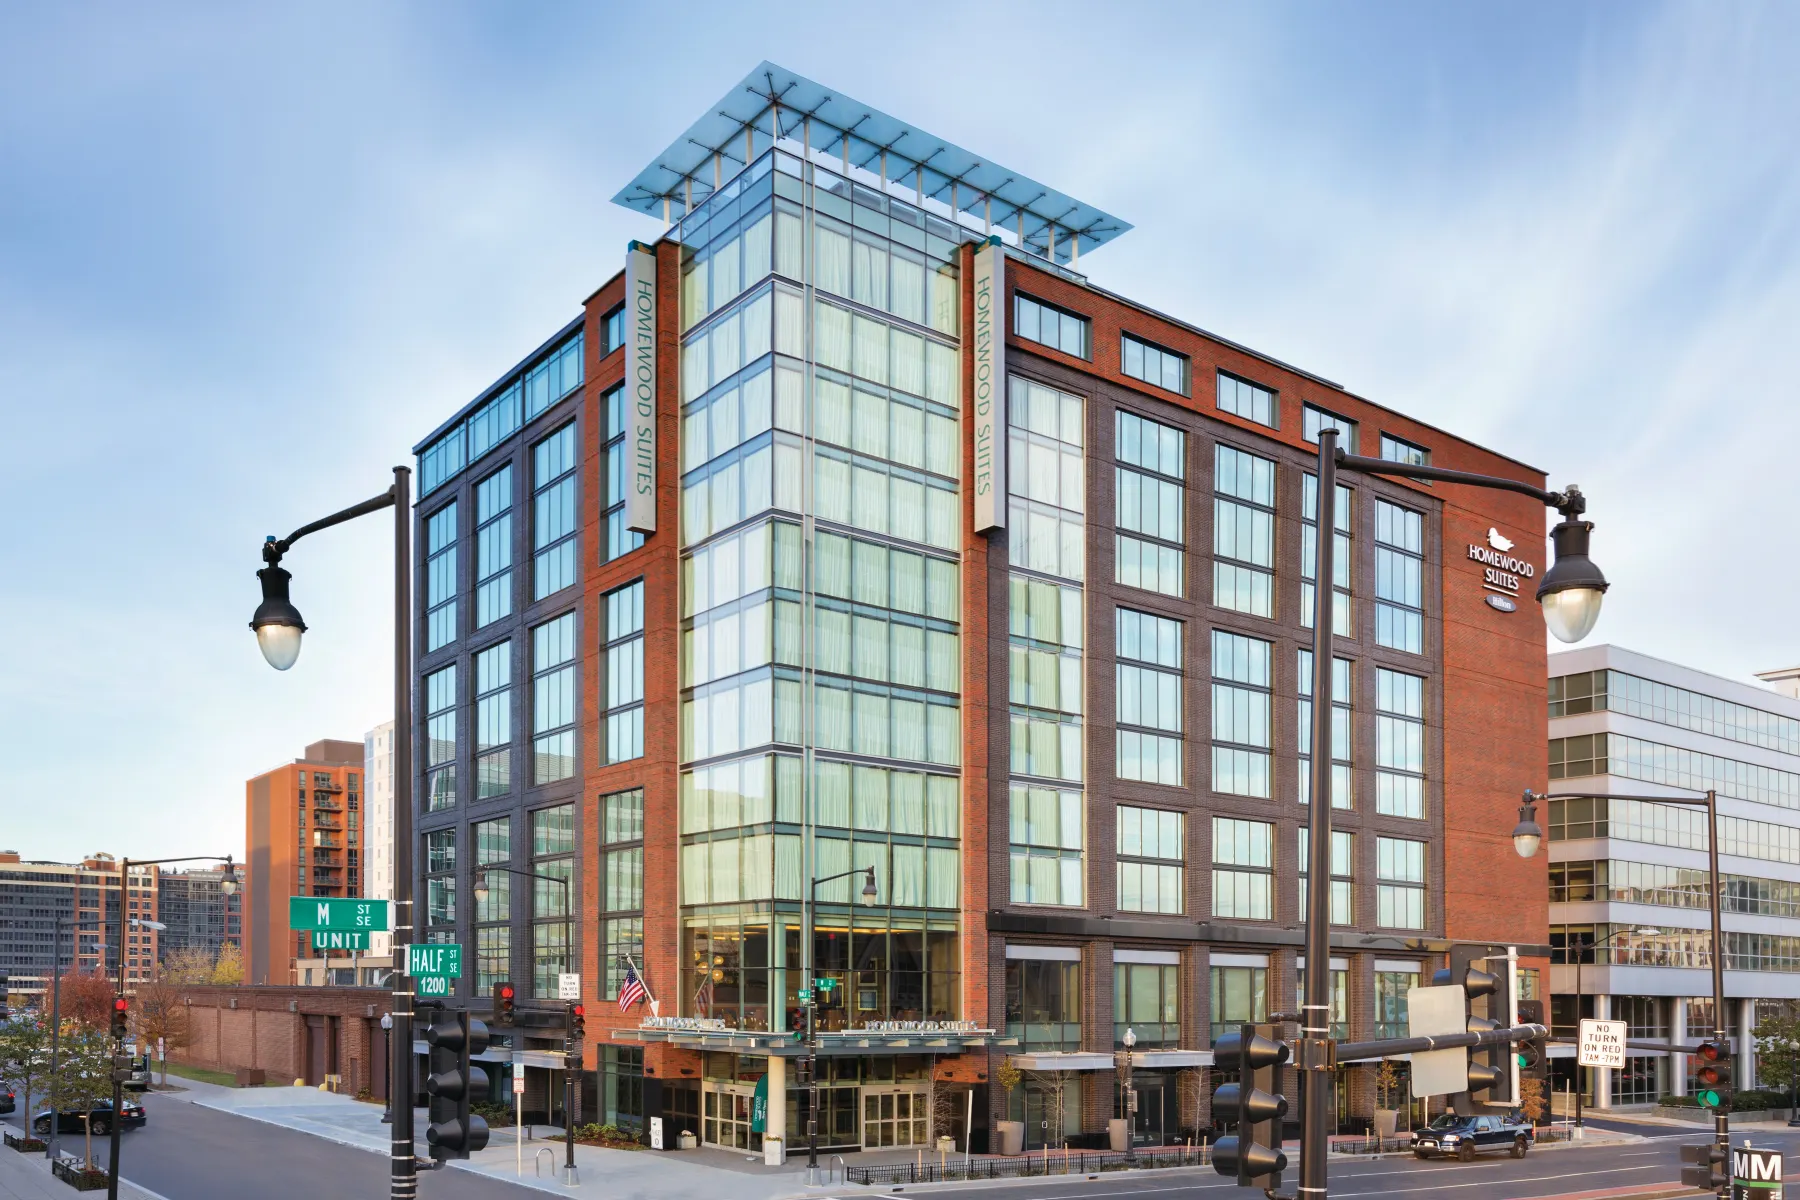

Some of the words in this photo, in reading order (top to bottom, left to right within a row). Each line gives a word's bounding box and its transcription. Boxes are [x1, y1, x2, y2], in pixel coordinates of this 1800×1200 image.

[637, 279, 653, 418] HOMEWOOD
[977, 275, 991, 416] HOMEWOOD
[636, 425, 653, 496] SUITES
[977, 423, 991, 496] SUITES
[1469, 544, 1534, 577] HOMEWOOD
[1485, 568, 1519, 590] SUITES
[317, 902, 330, 926] M
[357, 904, 371, 915] ST
[356, 916, 372, 926] SE
[316, 931, 362, 949] UNIT
[412, 949, 445, 973] HALF
[449, 949, 458, 959] ST
[449, 963, 458, 973] SE
[420, 976, 445, 994] 1200
[1588, 1033, 1618, 1043] TURN
[1596, 1024, 1610, 1033] NO
[1584, 1043, 1597, 1052] ON
[1602, 1044, 1621, 1054] RED
[1733, 1151, 1749, 1180] M
[1751, 1153, 1782, 1181] M
